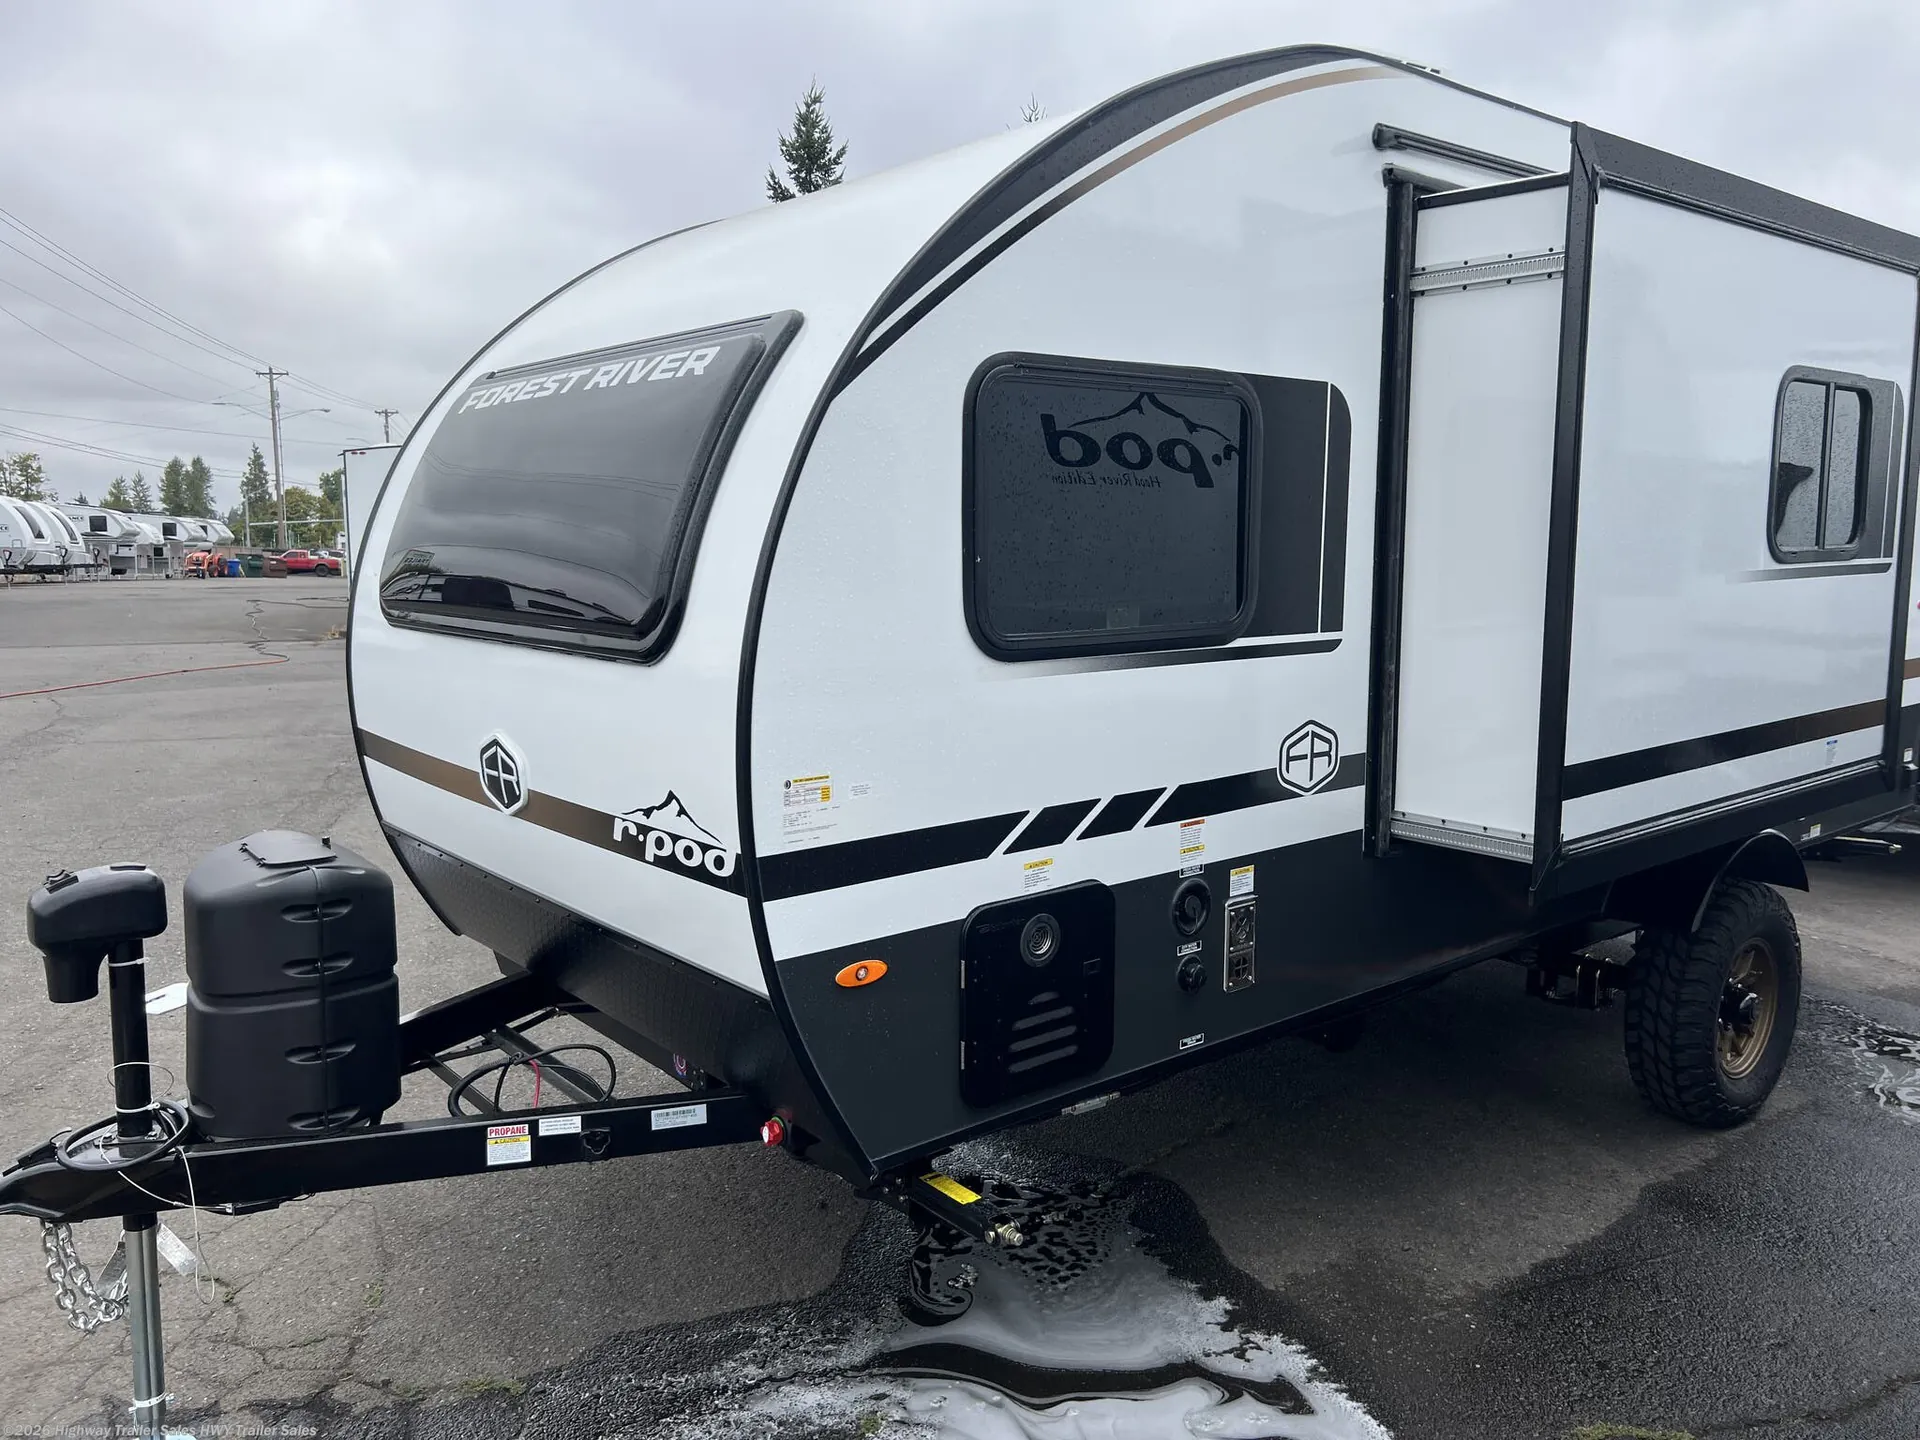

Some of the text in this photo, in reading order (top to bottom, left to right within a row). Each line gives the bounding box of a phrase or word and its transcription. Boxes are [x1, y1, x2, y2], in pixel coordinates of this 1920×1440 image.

[458, 346, 721, 415] FOREST RIVER
[489, 1125, 527, 1137] PROPANE
